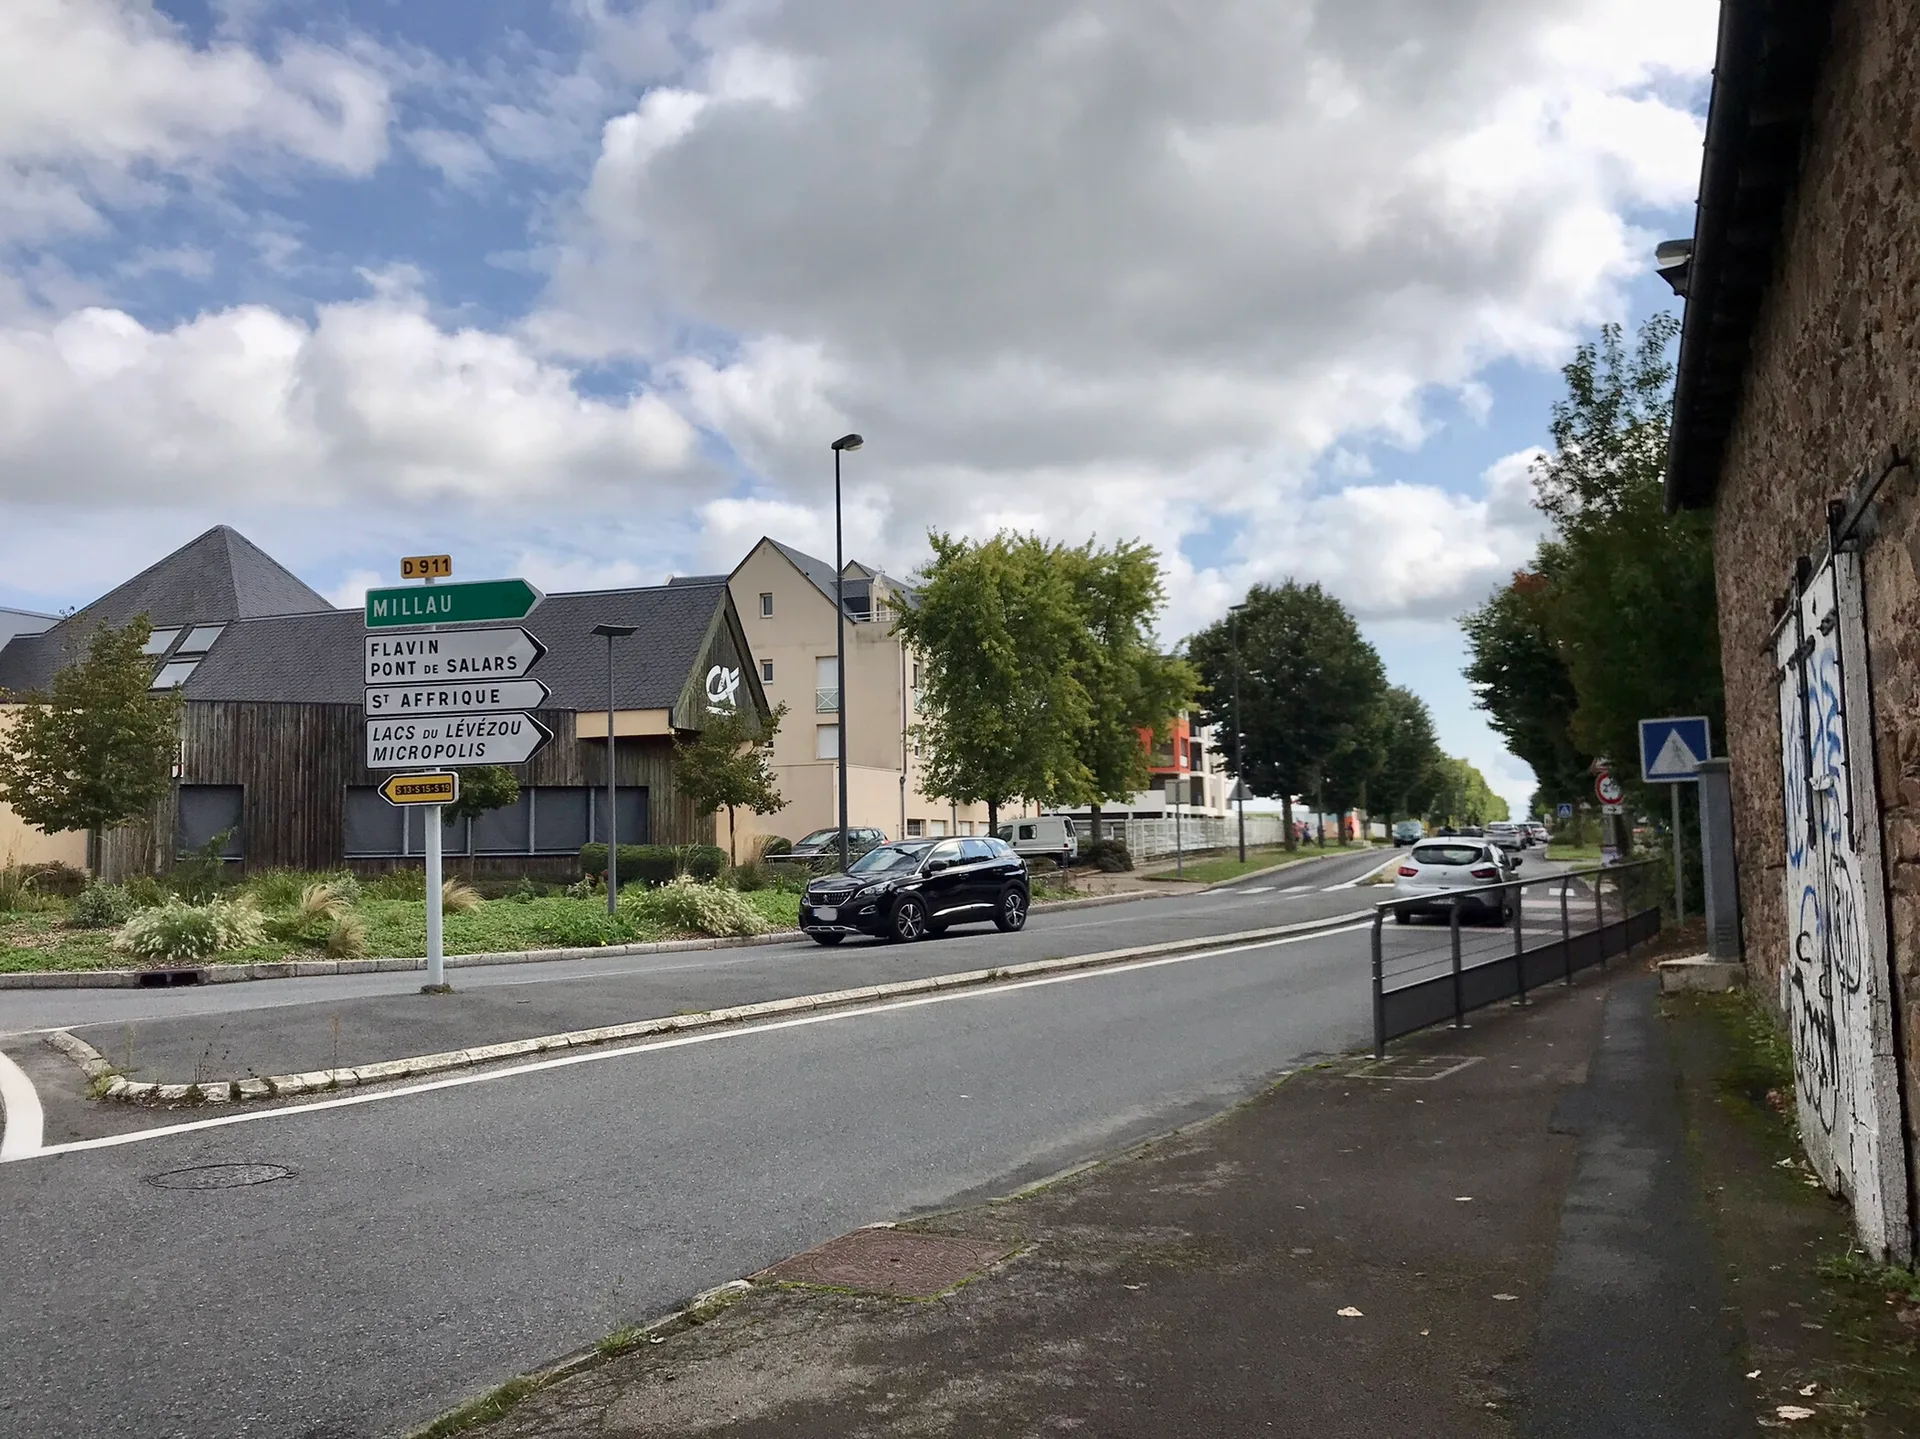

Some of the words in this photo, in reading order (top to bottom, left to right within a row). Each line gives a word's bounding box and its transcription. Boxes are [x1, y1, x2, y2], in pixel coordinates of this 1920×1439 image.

[403, 560, 413, 575] D
[419, 558, 449, 573] 911
[373, 595, 452, 617] MILLAU
[371, 640, 439, 657] FLAVIN
[371, 661, 416, 676] PONT
[424, 664, 439, 674] DE
[447, 656, 517, 672] SALARS
[401, 689, 500, 707] AFFRIQUE
[373, 725, 415, 741] LACS
[423, 728, 438, 739] DU
[446, 718, 522, 738] LÉVÉZOU
[373, 743, 486, 761] MICROPOLIS
